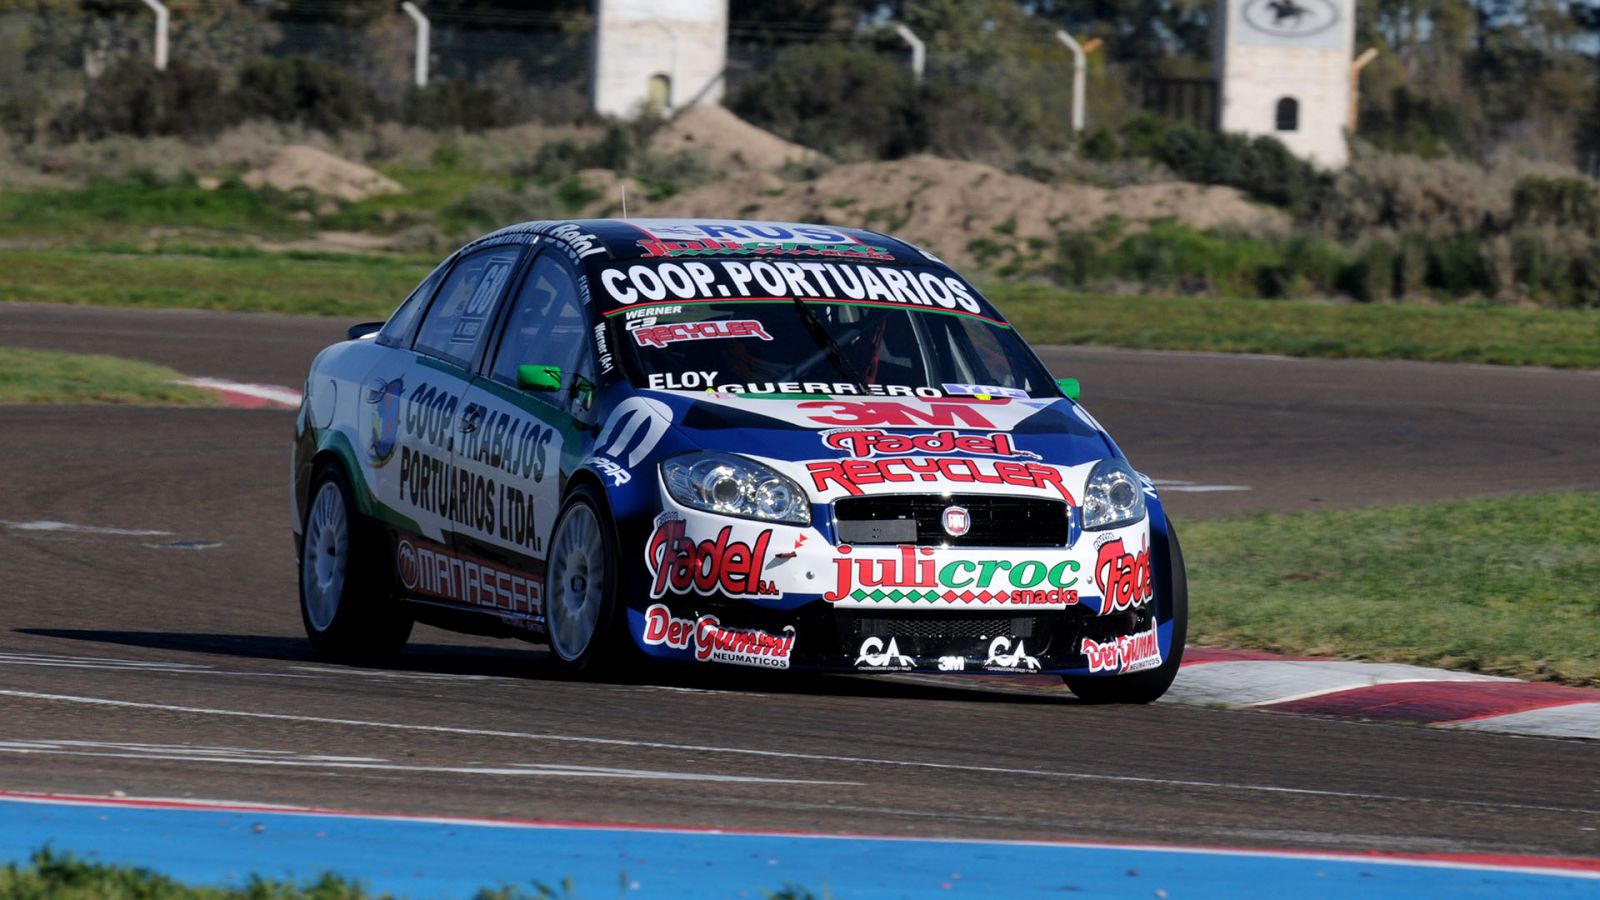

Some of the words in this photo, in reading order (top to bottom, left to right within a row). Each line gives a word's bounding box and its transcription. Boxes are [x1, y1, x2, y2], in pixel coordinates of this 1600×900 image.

[699, 224, 846, 242] RUS
[467, 265, 509, 314] 68
[625, 306, 682, 320] WERNER
[625, 317, 657, 331] C3
[594, 321, 608, 354] Werner
[648, 371, 718, 389] ELOY
[717, 382, 942, 398] GUERRERO
[955, 384, 1022, 398] YPF
[797, 401, 996, 428] 3M
[406, 382, 454, 451] COOP.
[460, 402, 552, 483] TRABAJOS
[827, 431, 1014, 457] Fadel
[400, 446, 495, 535] PORTUARIOS
[500, 480, 541, 552] LTDA.
[650, 518, 773, 595] Fadel
[759, 580, 780, 595] S.A.
[417, 548, 545, 614] MANASSER
[824, 544, 1081, 602] julicroc
[1010, 587, 1078, 605] snacks
[646, 607, 694, 646] Der
[697, 618, 795, 660] Gummi
[1083, 639, 1117, 668] Der
[1116, 619, 1157, 672] Gummi
[713, 652, 787, 668] NEUMATICOS
[937, 655, 965, 671] 3M
